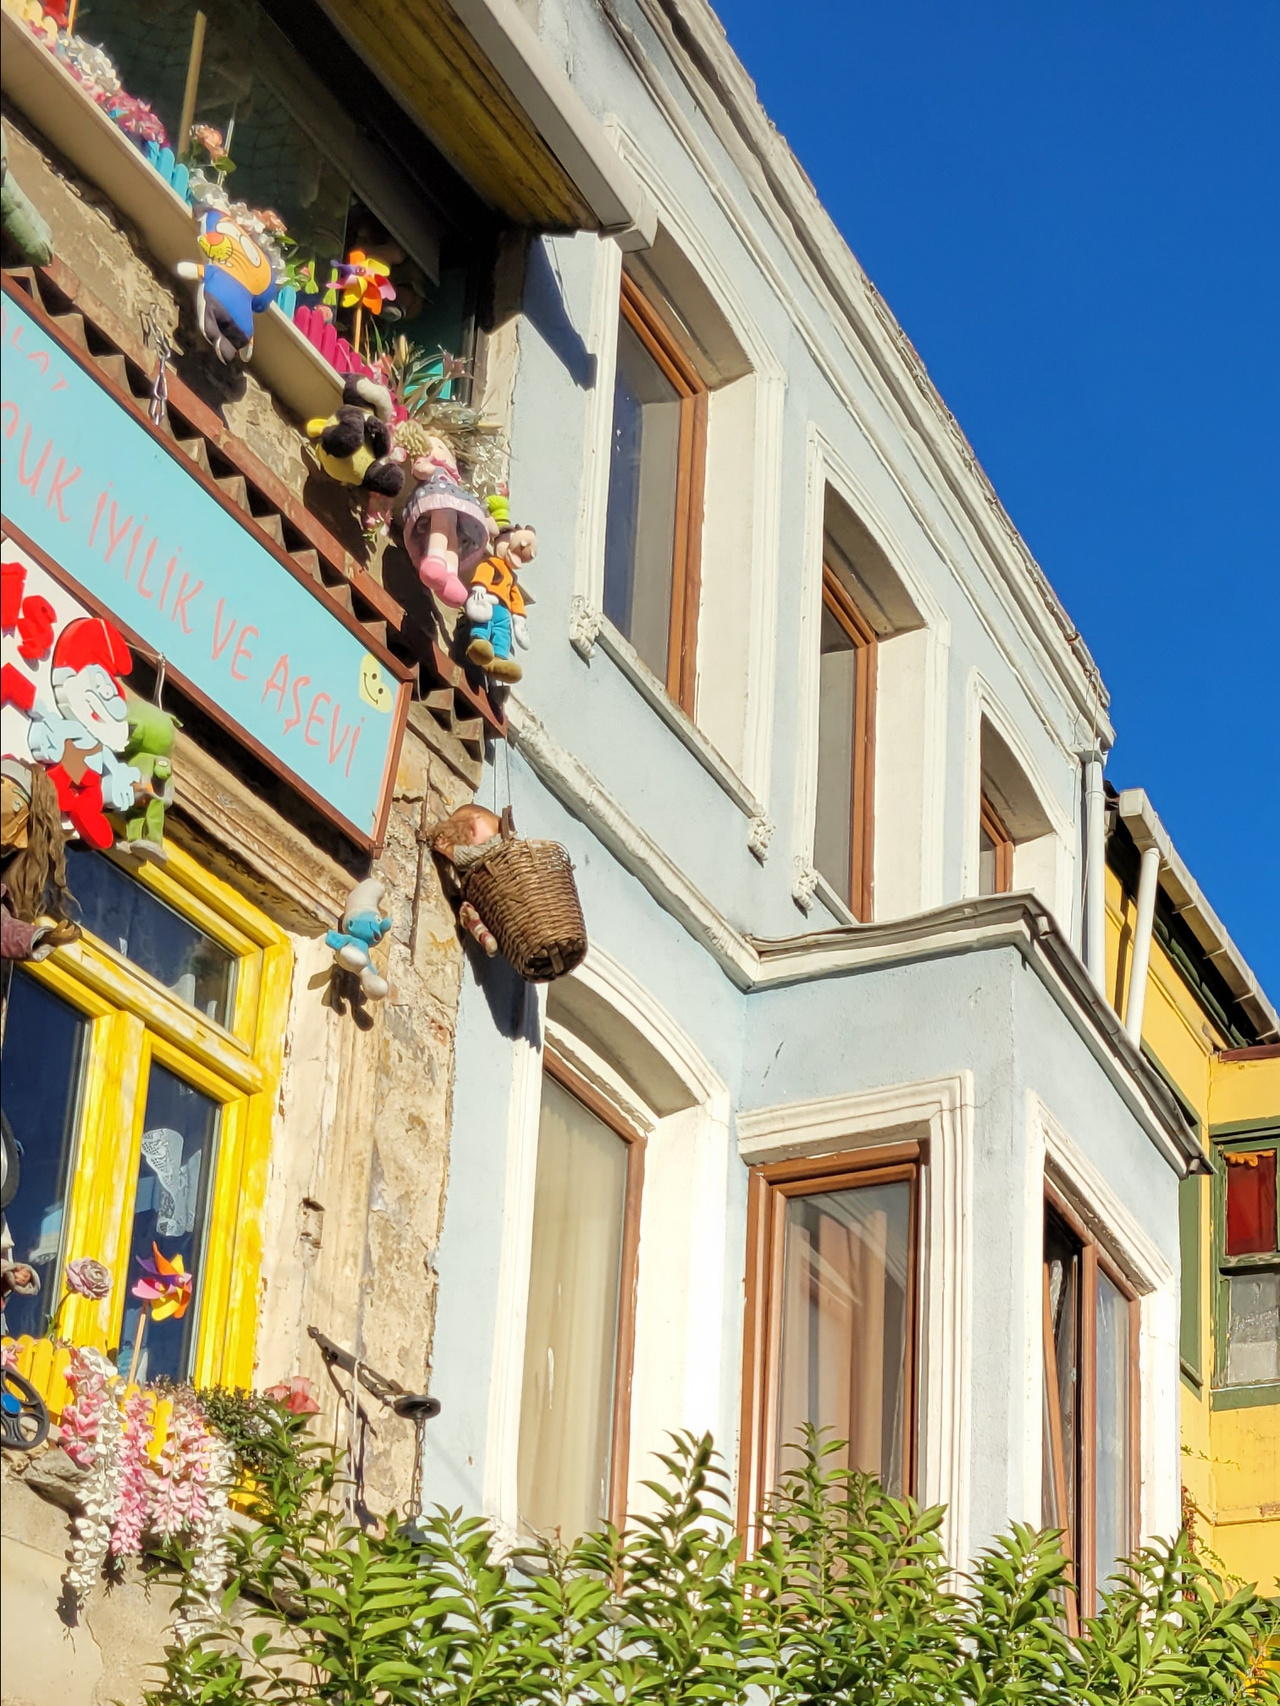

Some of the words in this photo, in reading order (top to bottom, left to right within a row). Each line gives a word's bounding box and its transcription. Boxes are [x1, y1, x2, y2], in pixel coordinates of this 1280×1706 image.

[88, 481, 205, 635] İYİLİK
[211, 597, 269, 682] VE
[261, 654, 365, 777] AŞEVİ
